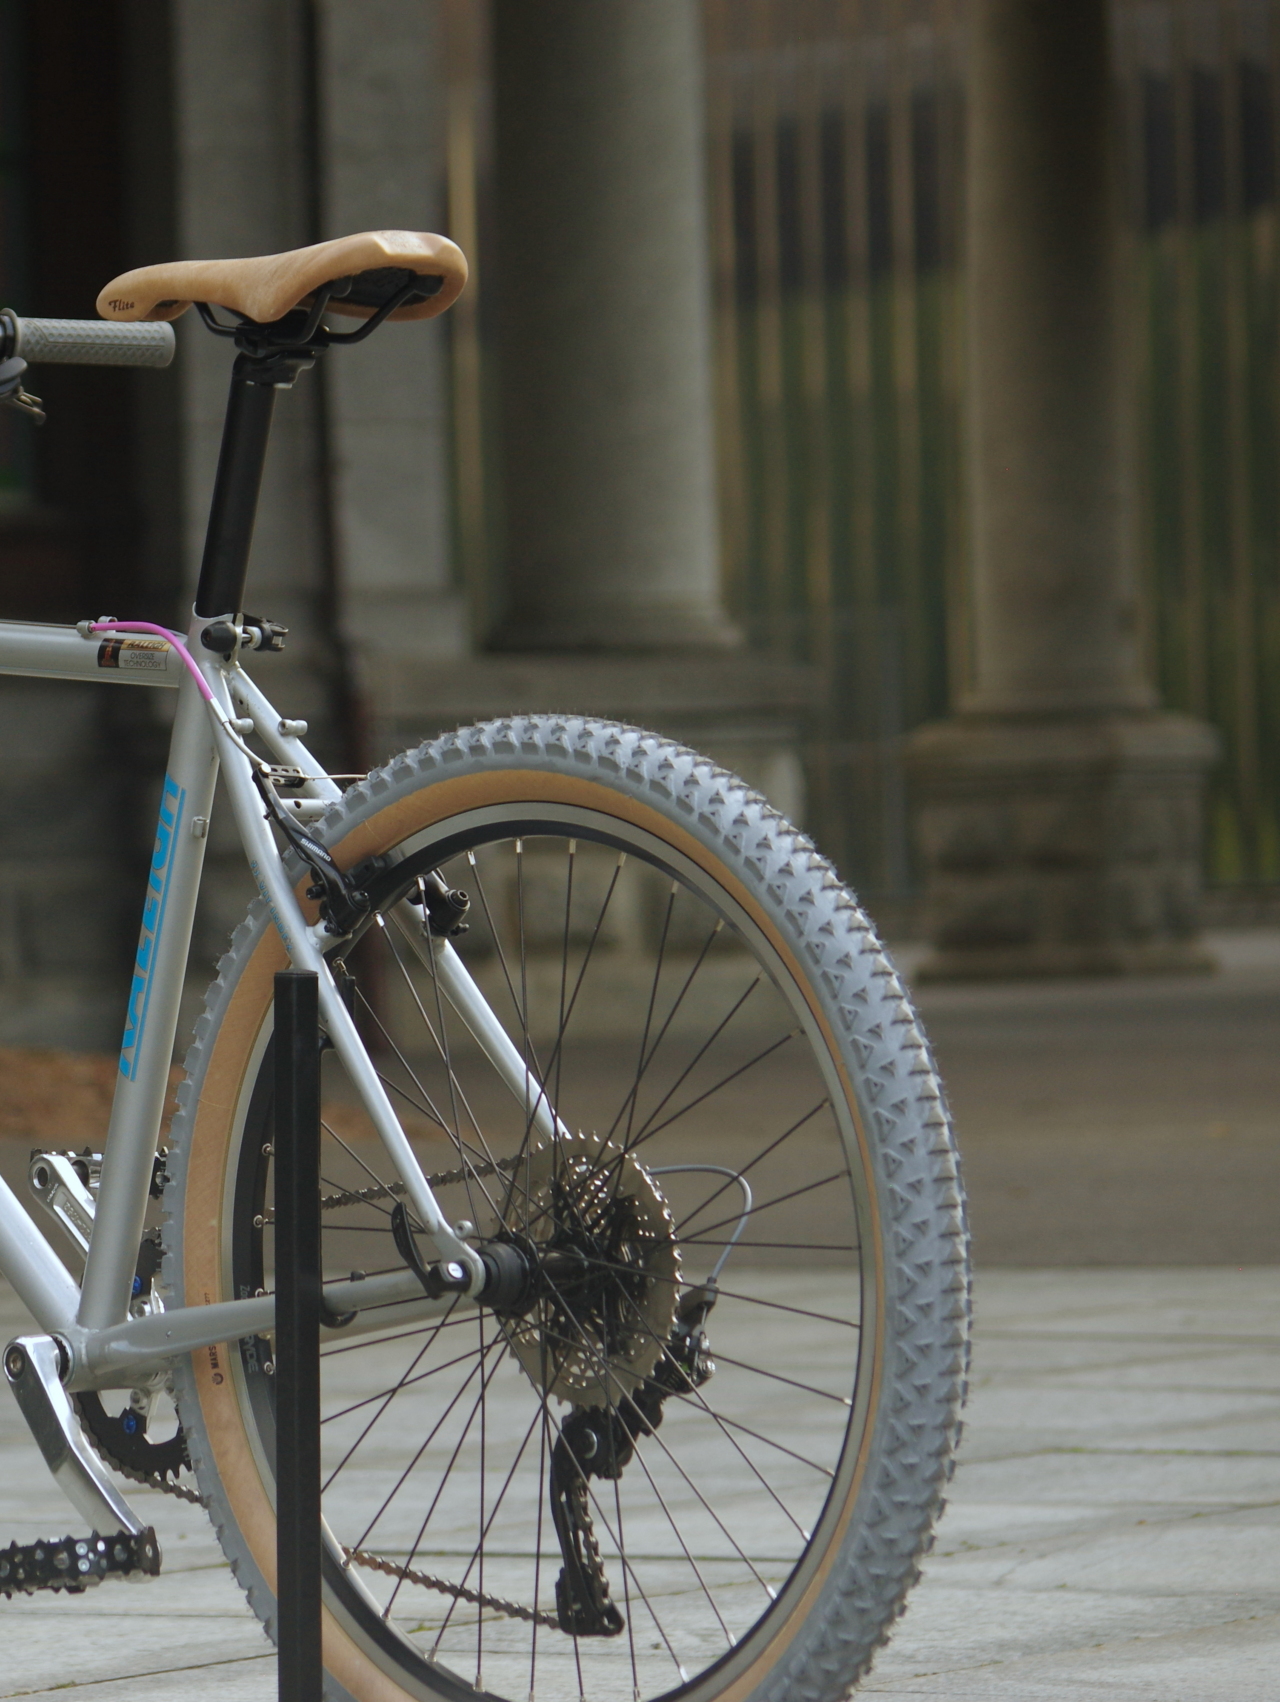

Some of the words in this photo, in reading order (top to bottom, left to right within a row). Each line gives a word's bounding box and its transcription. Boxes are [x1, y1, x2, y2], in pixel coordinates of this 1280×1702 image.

[108, 298, 135, 312] Flite
[130, 652, 156, 661] OVERSIZE
[124, 660, 162, 669] TECHNOLOGY
[300, 838, 332, 862] SHIMANO
[209, 1346, 219, 1370] MARS
